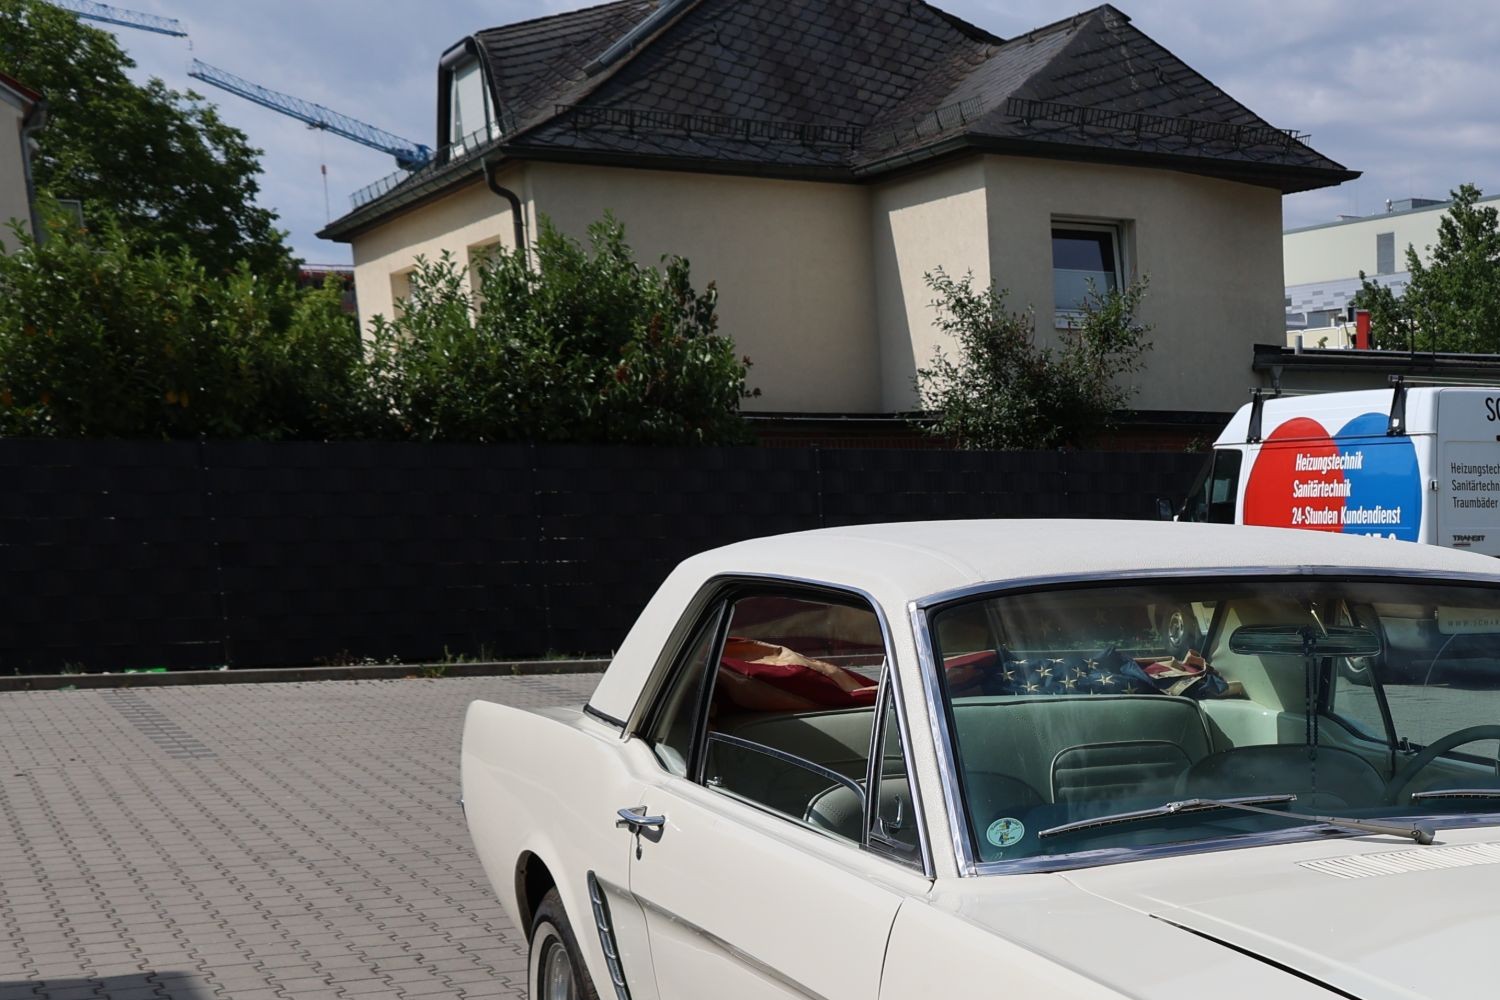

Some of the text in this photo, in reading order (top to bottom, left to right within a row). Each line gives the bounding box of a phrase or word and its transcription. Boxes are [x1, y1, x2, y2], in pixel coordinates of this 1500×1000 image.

[1295, 450, 1363, 474] Heizungstechnik
[1293, 479, 1352, 497] Sanitärtechnik
[1452, 496, 1499, 508] Traumbäder
[1291, 505, 1401, 524] 24-Stunden Kundendienst
